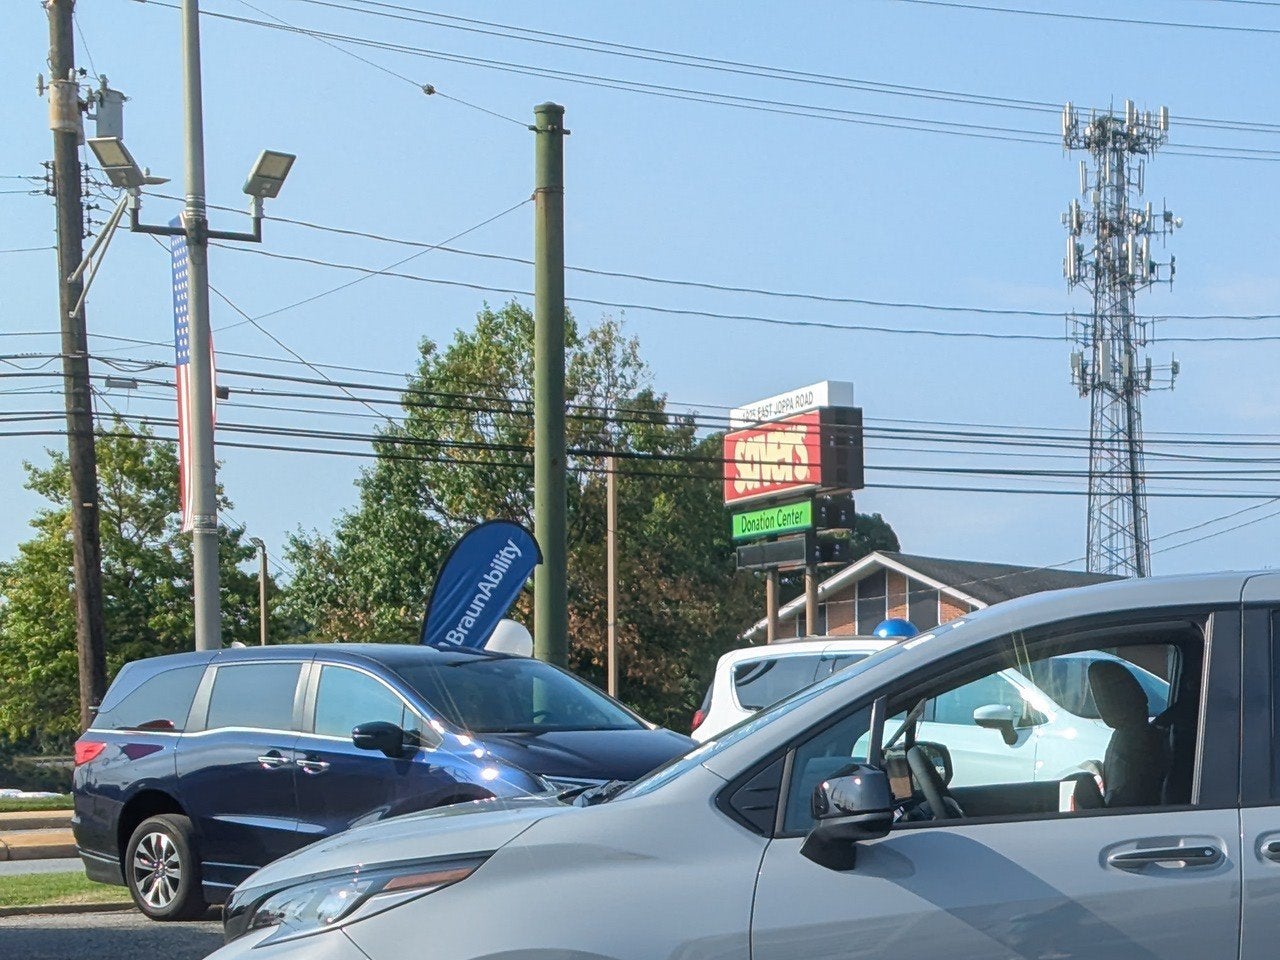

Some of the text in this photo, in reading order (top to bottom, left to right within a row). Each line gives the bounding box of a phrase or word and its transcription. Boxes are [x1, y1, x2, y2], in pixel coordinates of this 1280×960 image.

[757, 403, 773, 421] EAST
[773, 396, 794, 415] JOPPA
[795, 390, 814, 409] ROAD
[741, 508, 803, 533] Donation Center
[445, 538, 522, 646] BraunAbility
